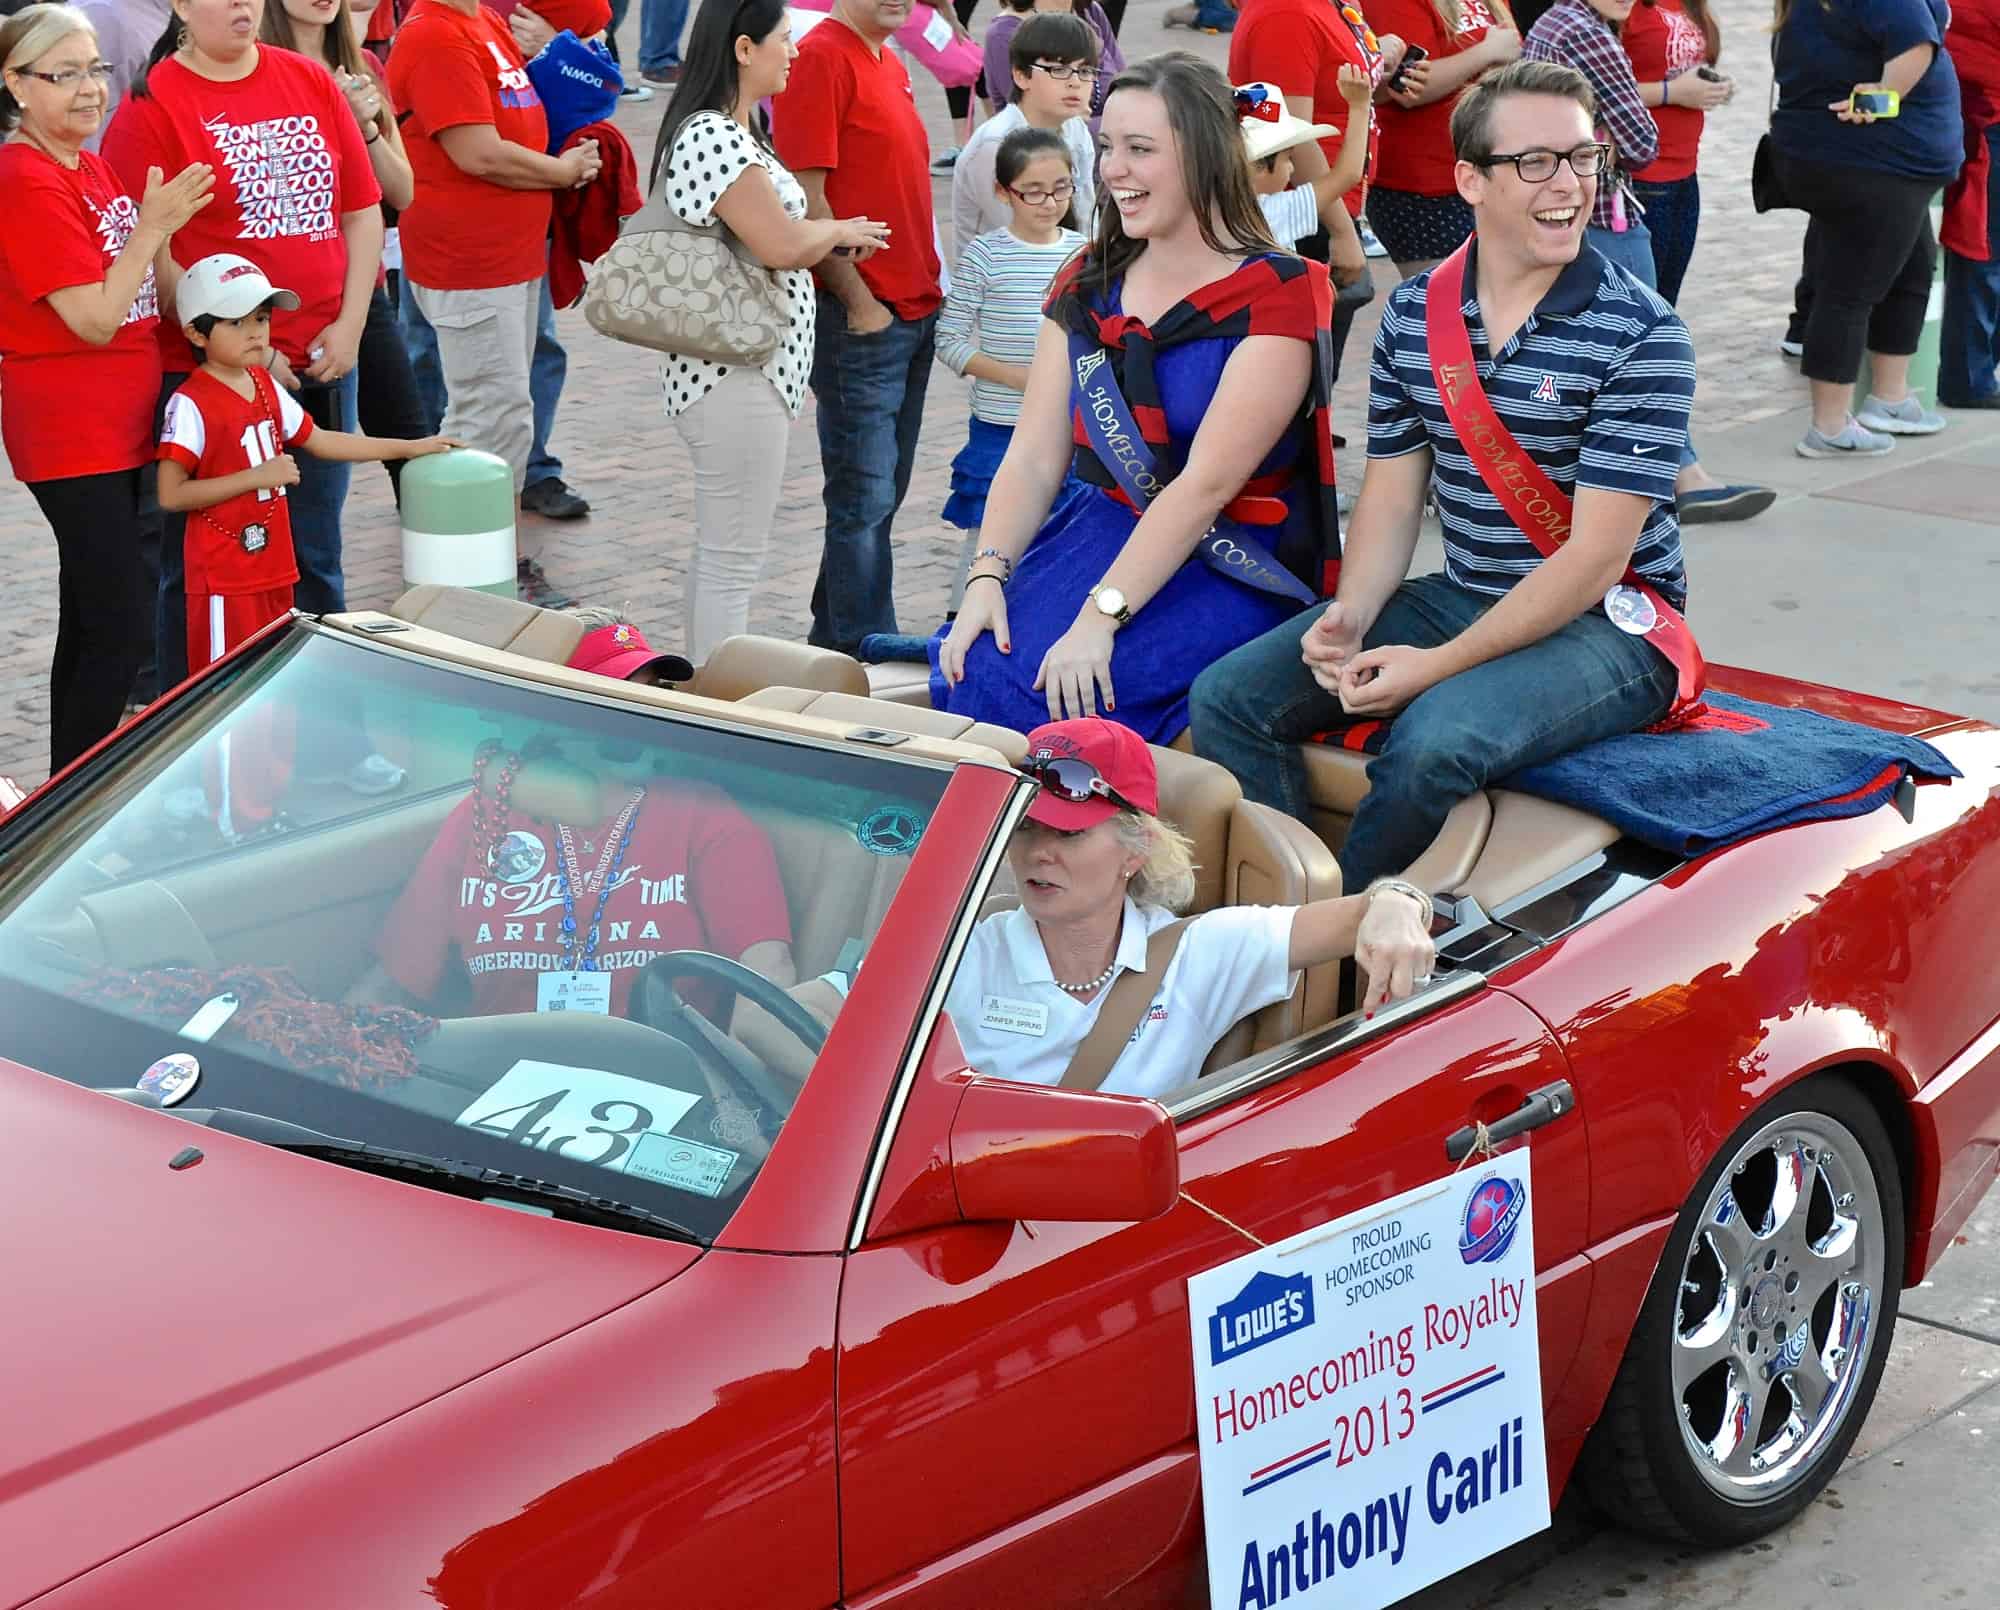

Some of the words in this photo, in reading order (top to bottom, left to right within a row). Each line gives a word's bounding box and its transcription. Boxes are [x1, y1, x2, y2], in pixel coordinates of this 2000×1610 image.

[561, 65, 603, 88] DOWN
[1089, 387, 1165, 497] HOMECO
[1463, 409, 1570, 544] HOMECOM
[461, 878, 497, 908] IT'S
[640, 874, 687, 904] TIME
[476, 920, 660, 944] ARINA
[470, 1089, 653, 1166] 43
[1325, 1232, 1432, 1290] HOMECOMING
[1352, 1220, 1402, 1254] PROUD
[1345, 1265, 1415, 1306] SPONSOR
[1213, 1324, 1415, 1444] Homecoming
[1424, 1277, 1525, 1352] Royalty
[1334, 1387, 1415, 1468] 2013
[1238, 1485, 1412, 1610] Anthony
[1427, 1415, 1522, 1525] Carli
